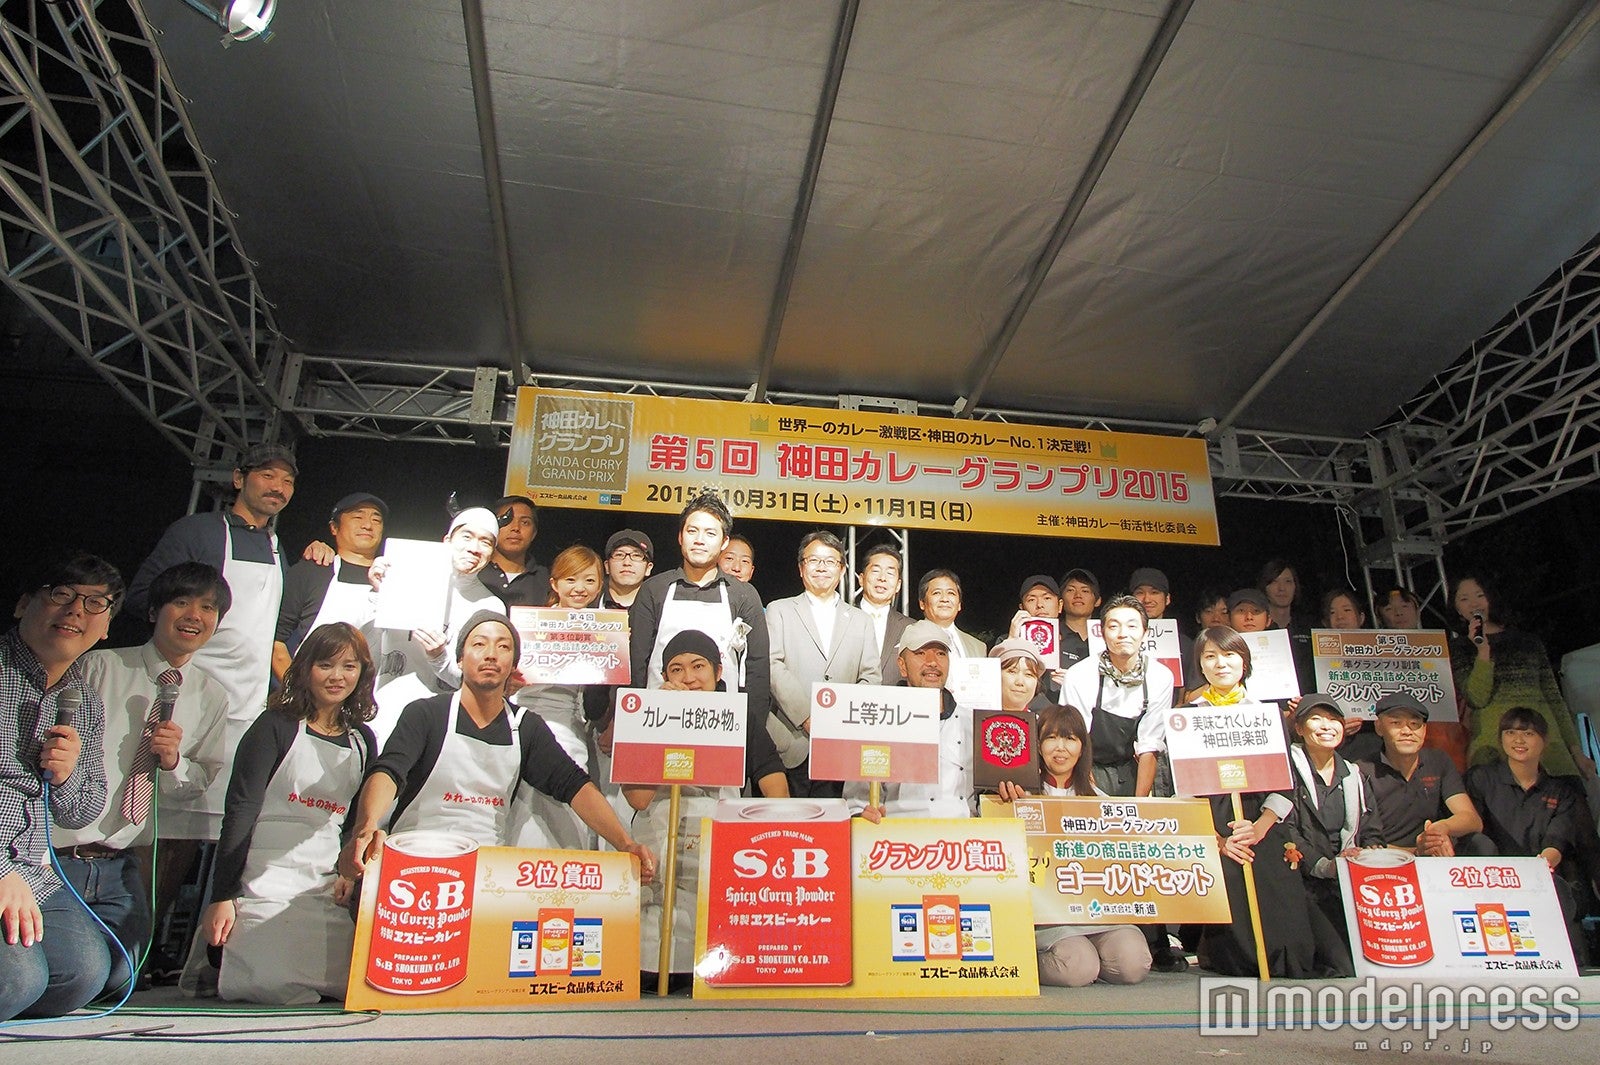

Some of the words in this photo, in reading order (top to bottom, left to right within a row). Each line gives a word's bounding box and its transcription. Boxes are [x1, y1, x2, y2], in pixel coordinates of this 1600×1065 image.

[541, 410, 625, 430] 神田カレー
[538, 431, 625, 455] グランプリ
[537, 455, 580, 468] KANDA
[583, 458, 622, 470] CURRY
[541, 468, 586, 480] GRAND
[589, 472, 615, 482] PRIX
[1344, 645, 1443, 656] 神田カレーグランプリ
[642, 706, 740, 732] カレーは飲み物。
[842, 701, 930, 727] 上等カレー
[1192, 712, 1272, 731] 美味これくしょん
[1102, 804, 1137, 817] 第5回
[1062, 818, 1178, 833] 神田カレーグランプリ
[782, 830, 799, 839] TRADE
[869, 841, 962, 872] グランプリ
[965, 841, 1007, 872] 賞品
[1054, 842, 1206, 859] 新進の商品詰め合わせ
[563, 862, 602, 889] 賞品
[1056, 862, 1213, 895] ゴールドセット
[1485, 867, 1520, 888] 賞品
[726, 886, 757, 906] Spicy
[758, 886, 793, 905] Curry
[795, 886, 836, 906] Powder
[399, 911, 435, 929] Curry
[437, 906, 471, 928] Powder
[394, 953, 429, 962] PREPARED
[758, 955, 796, 964] SHOKUHIN
[1485, 960, 1562, 970] エスビー食品株式会社
[395, 963, 433, 974] SHOKUHIN
[920, 966, 1020, 979] エスビー食品株式会社
[391, 977, 413, 985] TOKYO
[420, 976, 442, 985] JAPAN
[529, 980, 624, 995] エスビー食品株式会社
